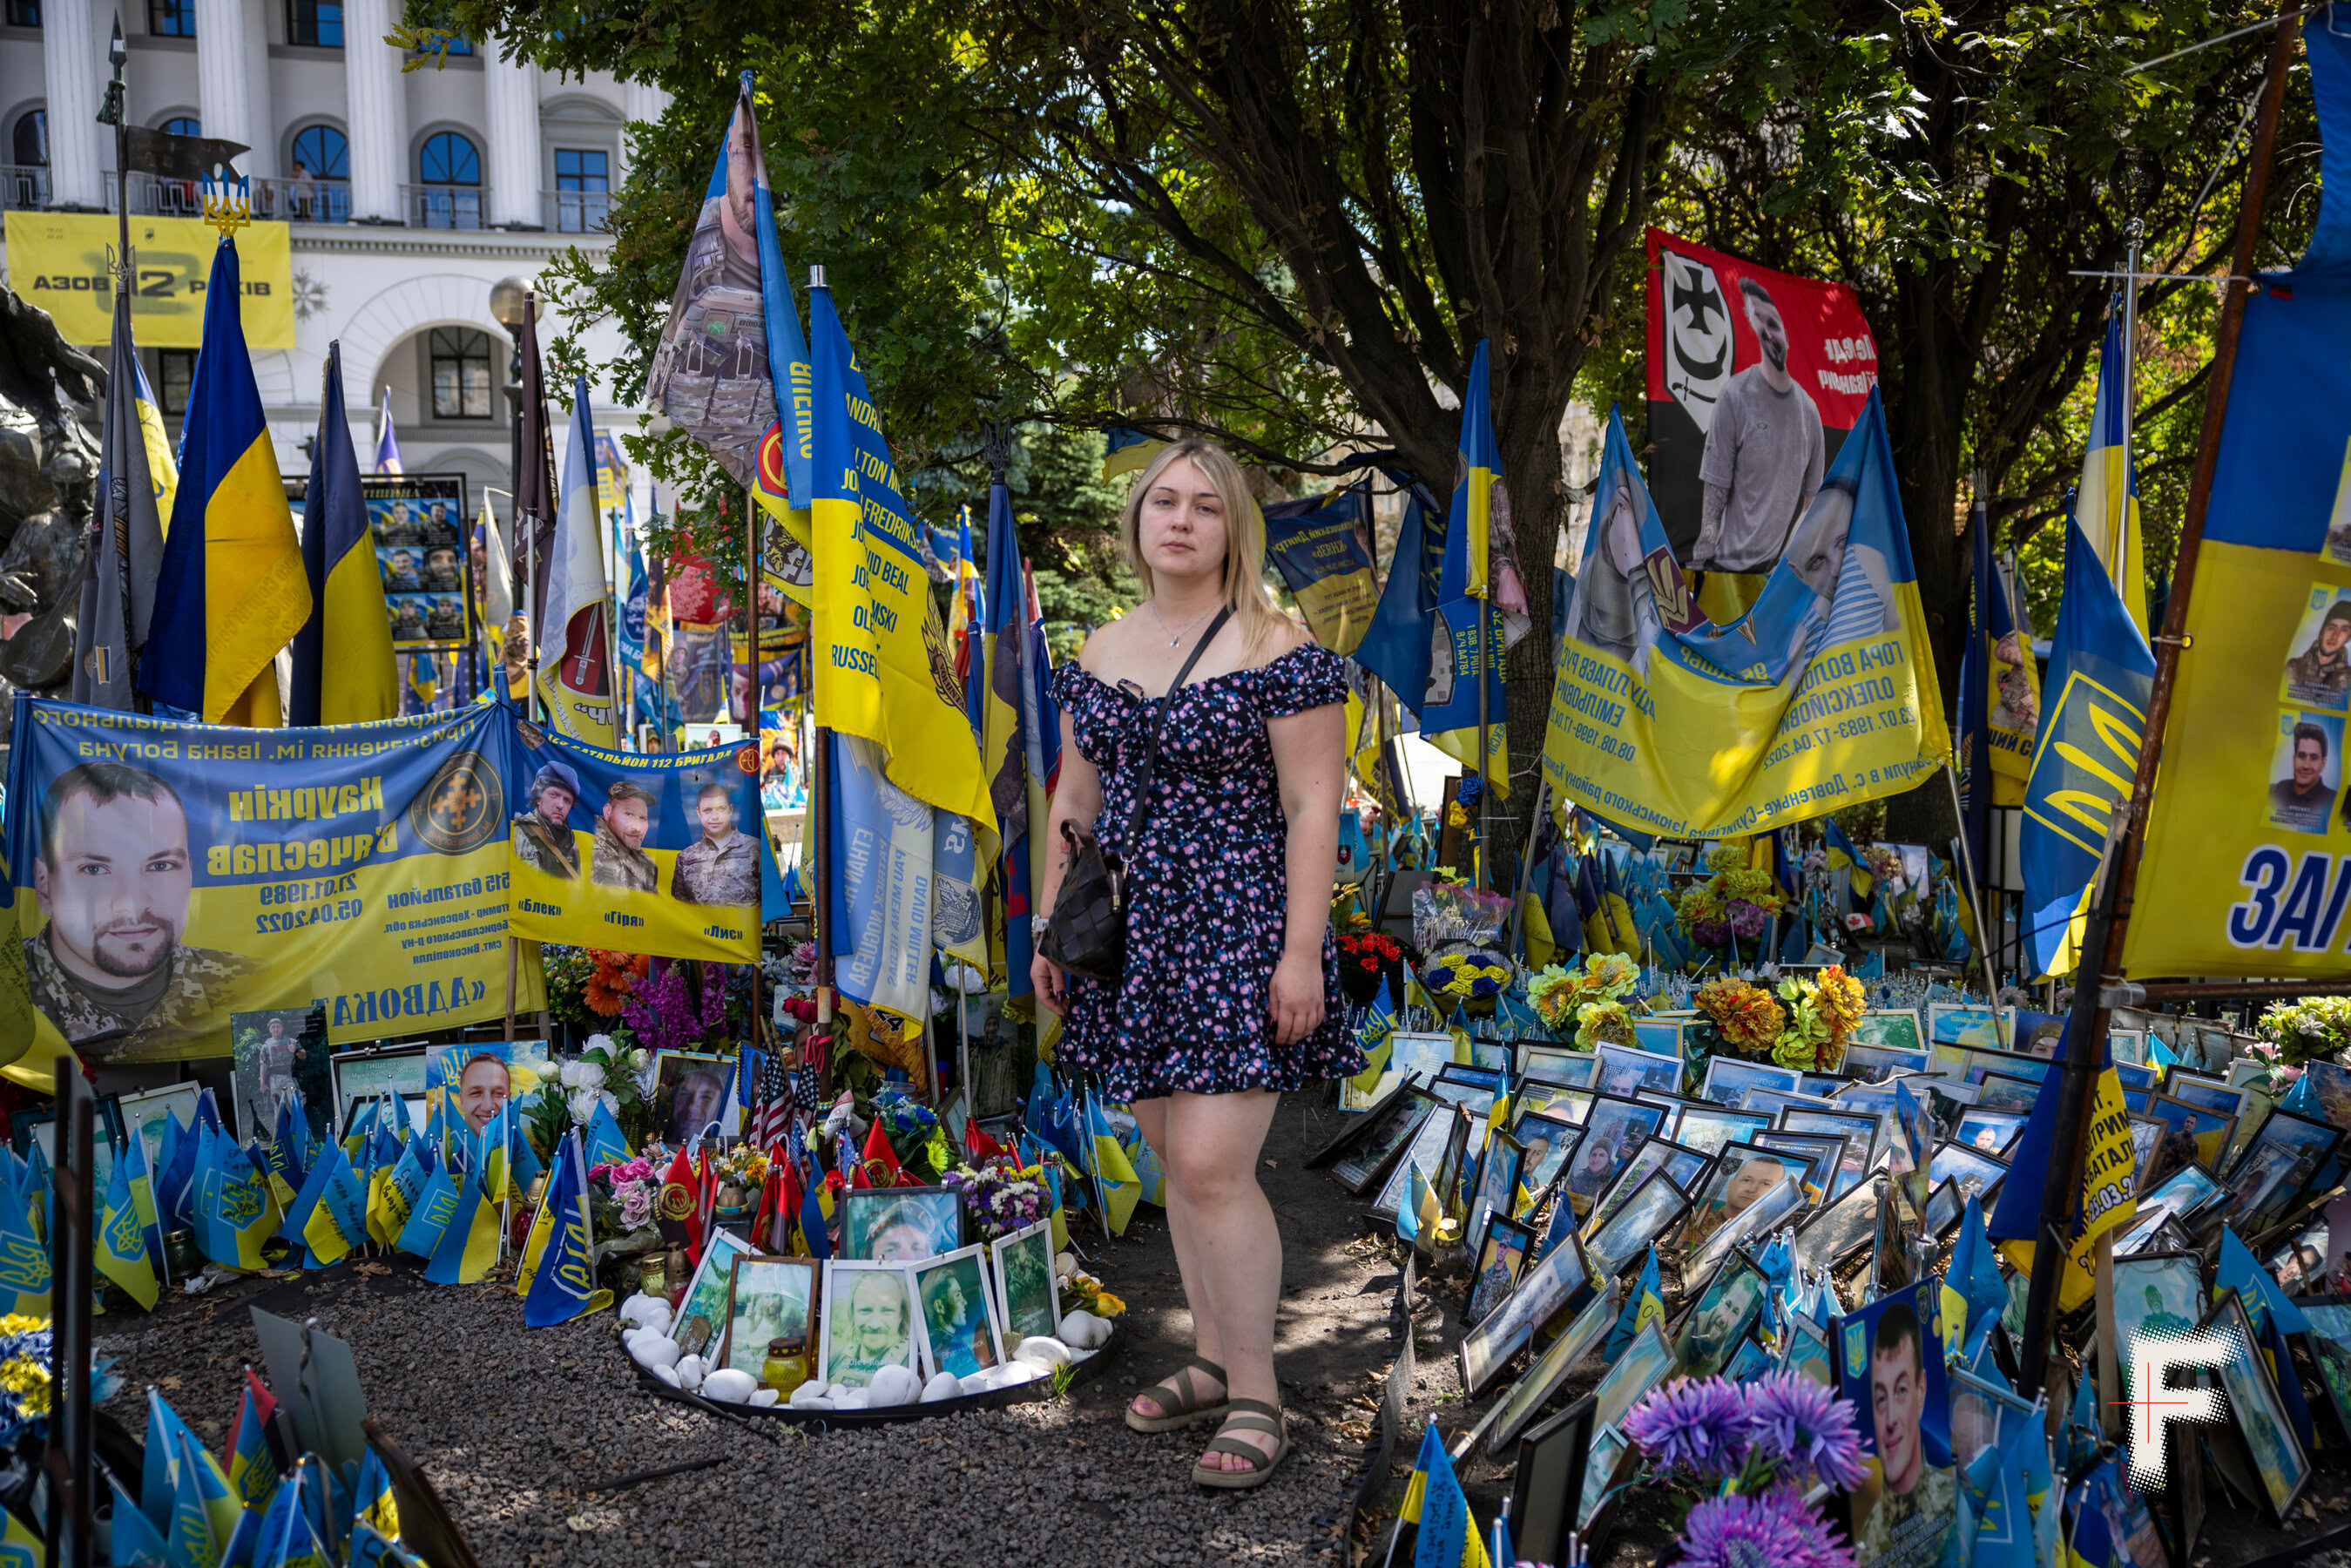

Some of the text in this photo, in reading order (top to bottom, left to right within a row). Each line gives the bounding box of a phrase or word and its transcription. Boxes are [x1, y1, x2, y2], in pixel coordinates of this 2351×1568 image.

[33, 275, 110, 291] АЗОВ
[189, 279, 271, 295] РІВ
[882, 560, 909, 596] BEAL
[652, 758, 672, 769] 112
[518, 898, 562, 916] «Блек»
[604, 910, 645, 928] «Гіря»
[704, 924, 743, 941] «Лис»
